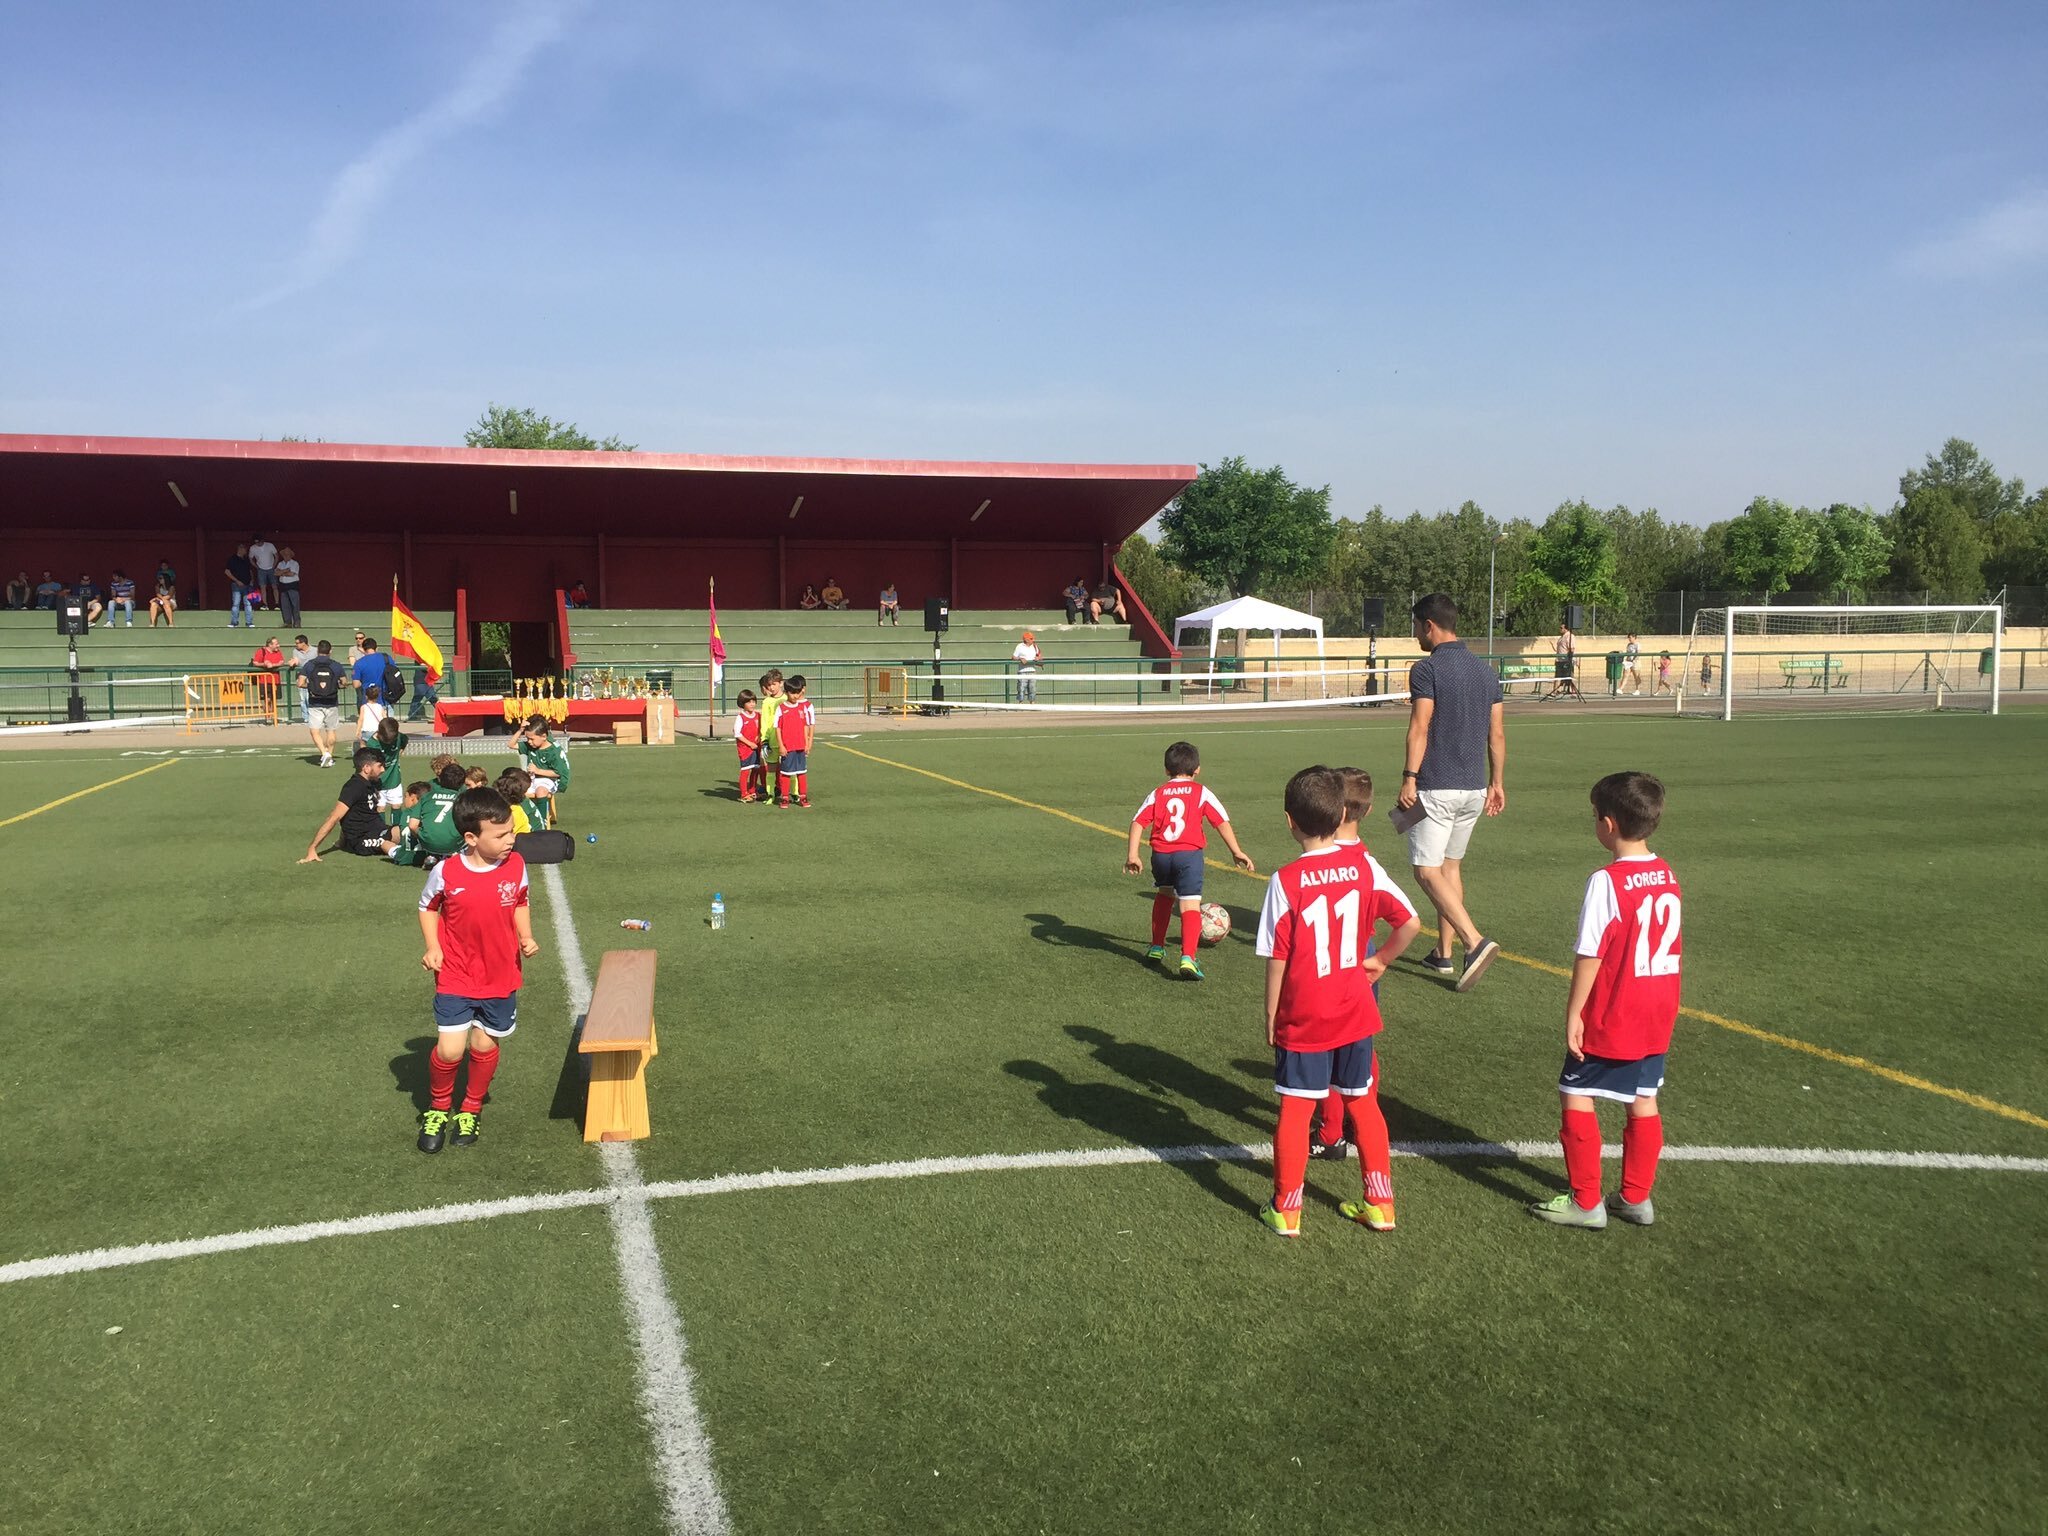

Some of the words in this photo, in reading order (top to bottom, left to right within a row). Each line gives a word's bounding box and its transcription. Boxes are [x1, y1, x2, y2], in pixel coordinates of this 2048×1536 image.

[223, 680, 244, 695] AYTO
[1163, 786, 1192, 796] MANU
[434, 800, 454, 823] 7
[1163, 797, 1186, 842] 3
[1300, 865, 1360, 888] ÁLVARO
[1624, 869, 1665, 891] JORGE
[1301, 888, 1360, 979] 11
[1634, 892, 1681, 977] 12
